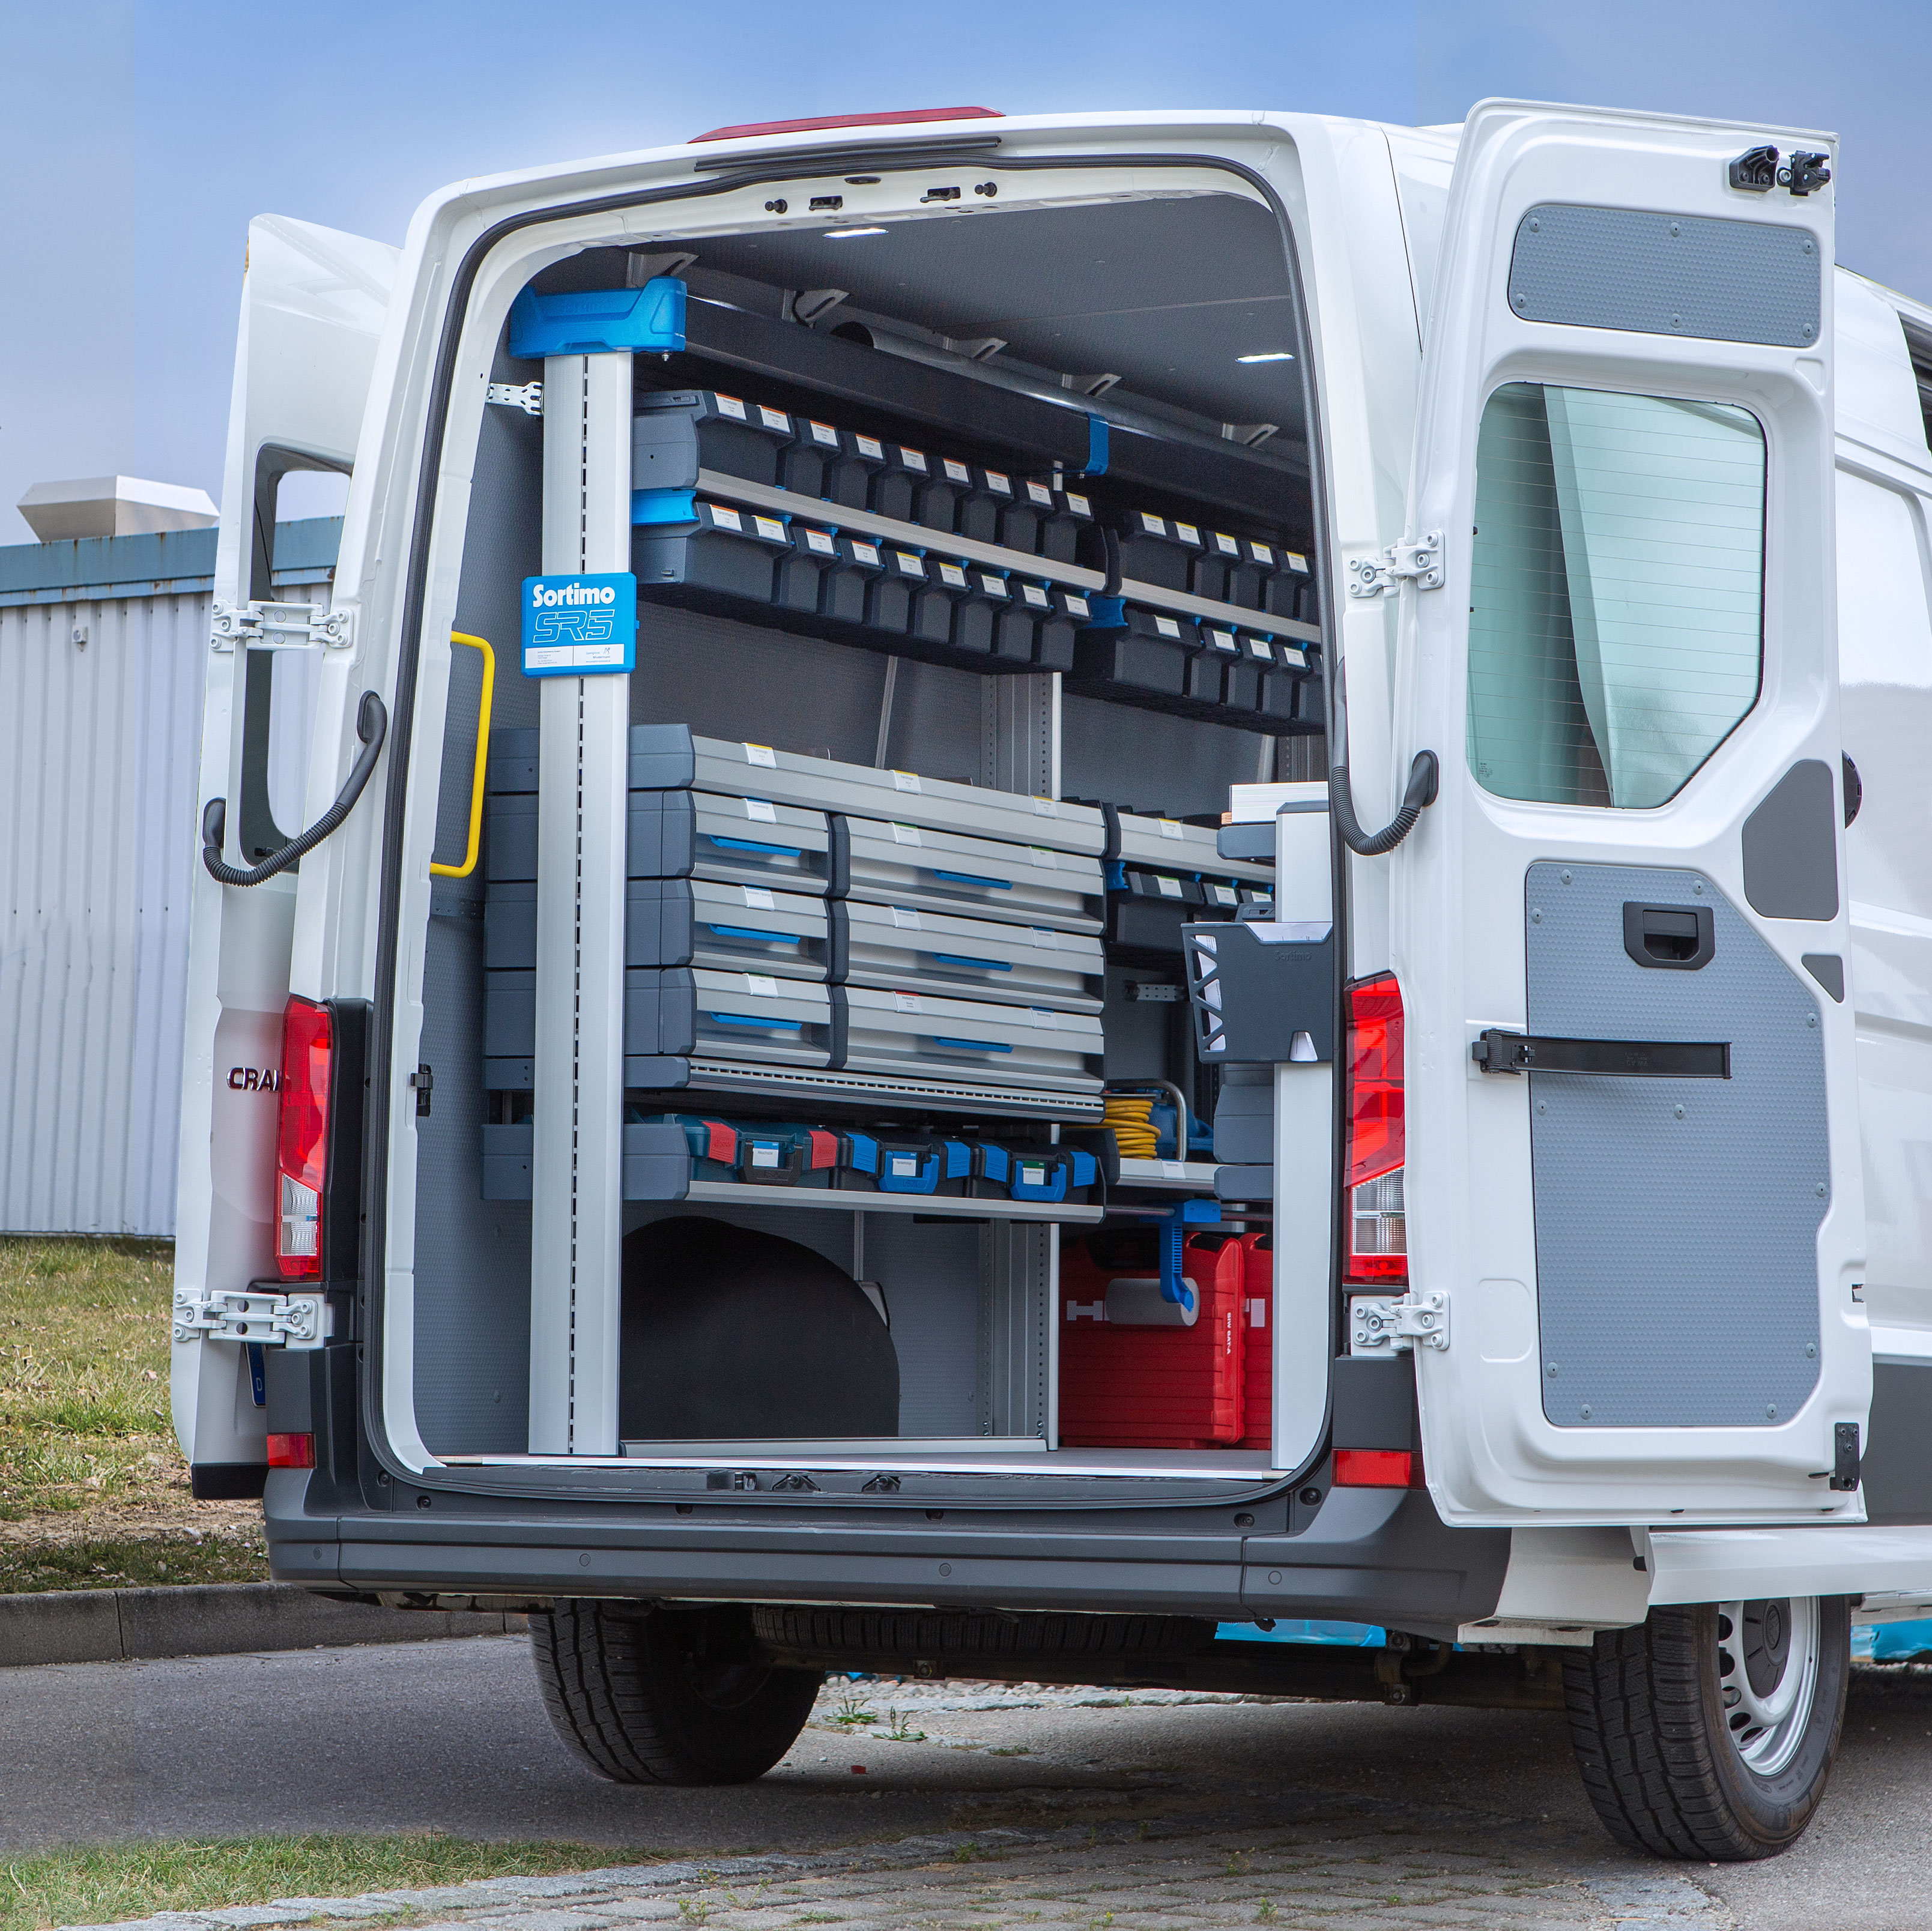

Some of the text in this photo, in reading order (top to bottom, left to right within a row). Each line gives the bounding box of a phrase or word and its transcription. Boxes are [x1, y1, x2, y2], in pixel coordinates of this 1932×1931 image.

[533, 582, 616, 608] Sortimo
[533, 609, 616, 643] SR5
[1274, 950, 1312, 962] Sortimo
[256, 1377, 262, 1392] D
